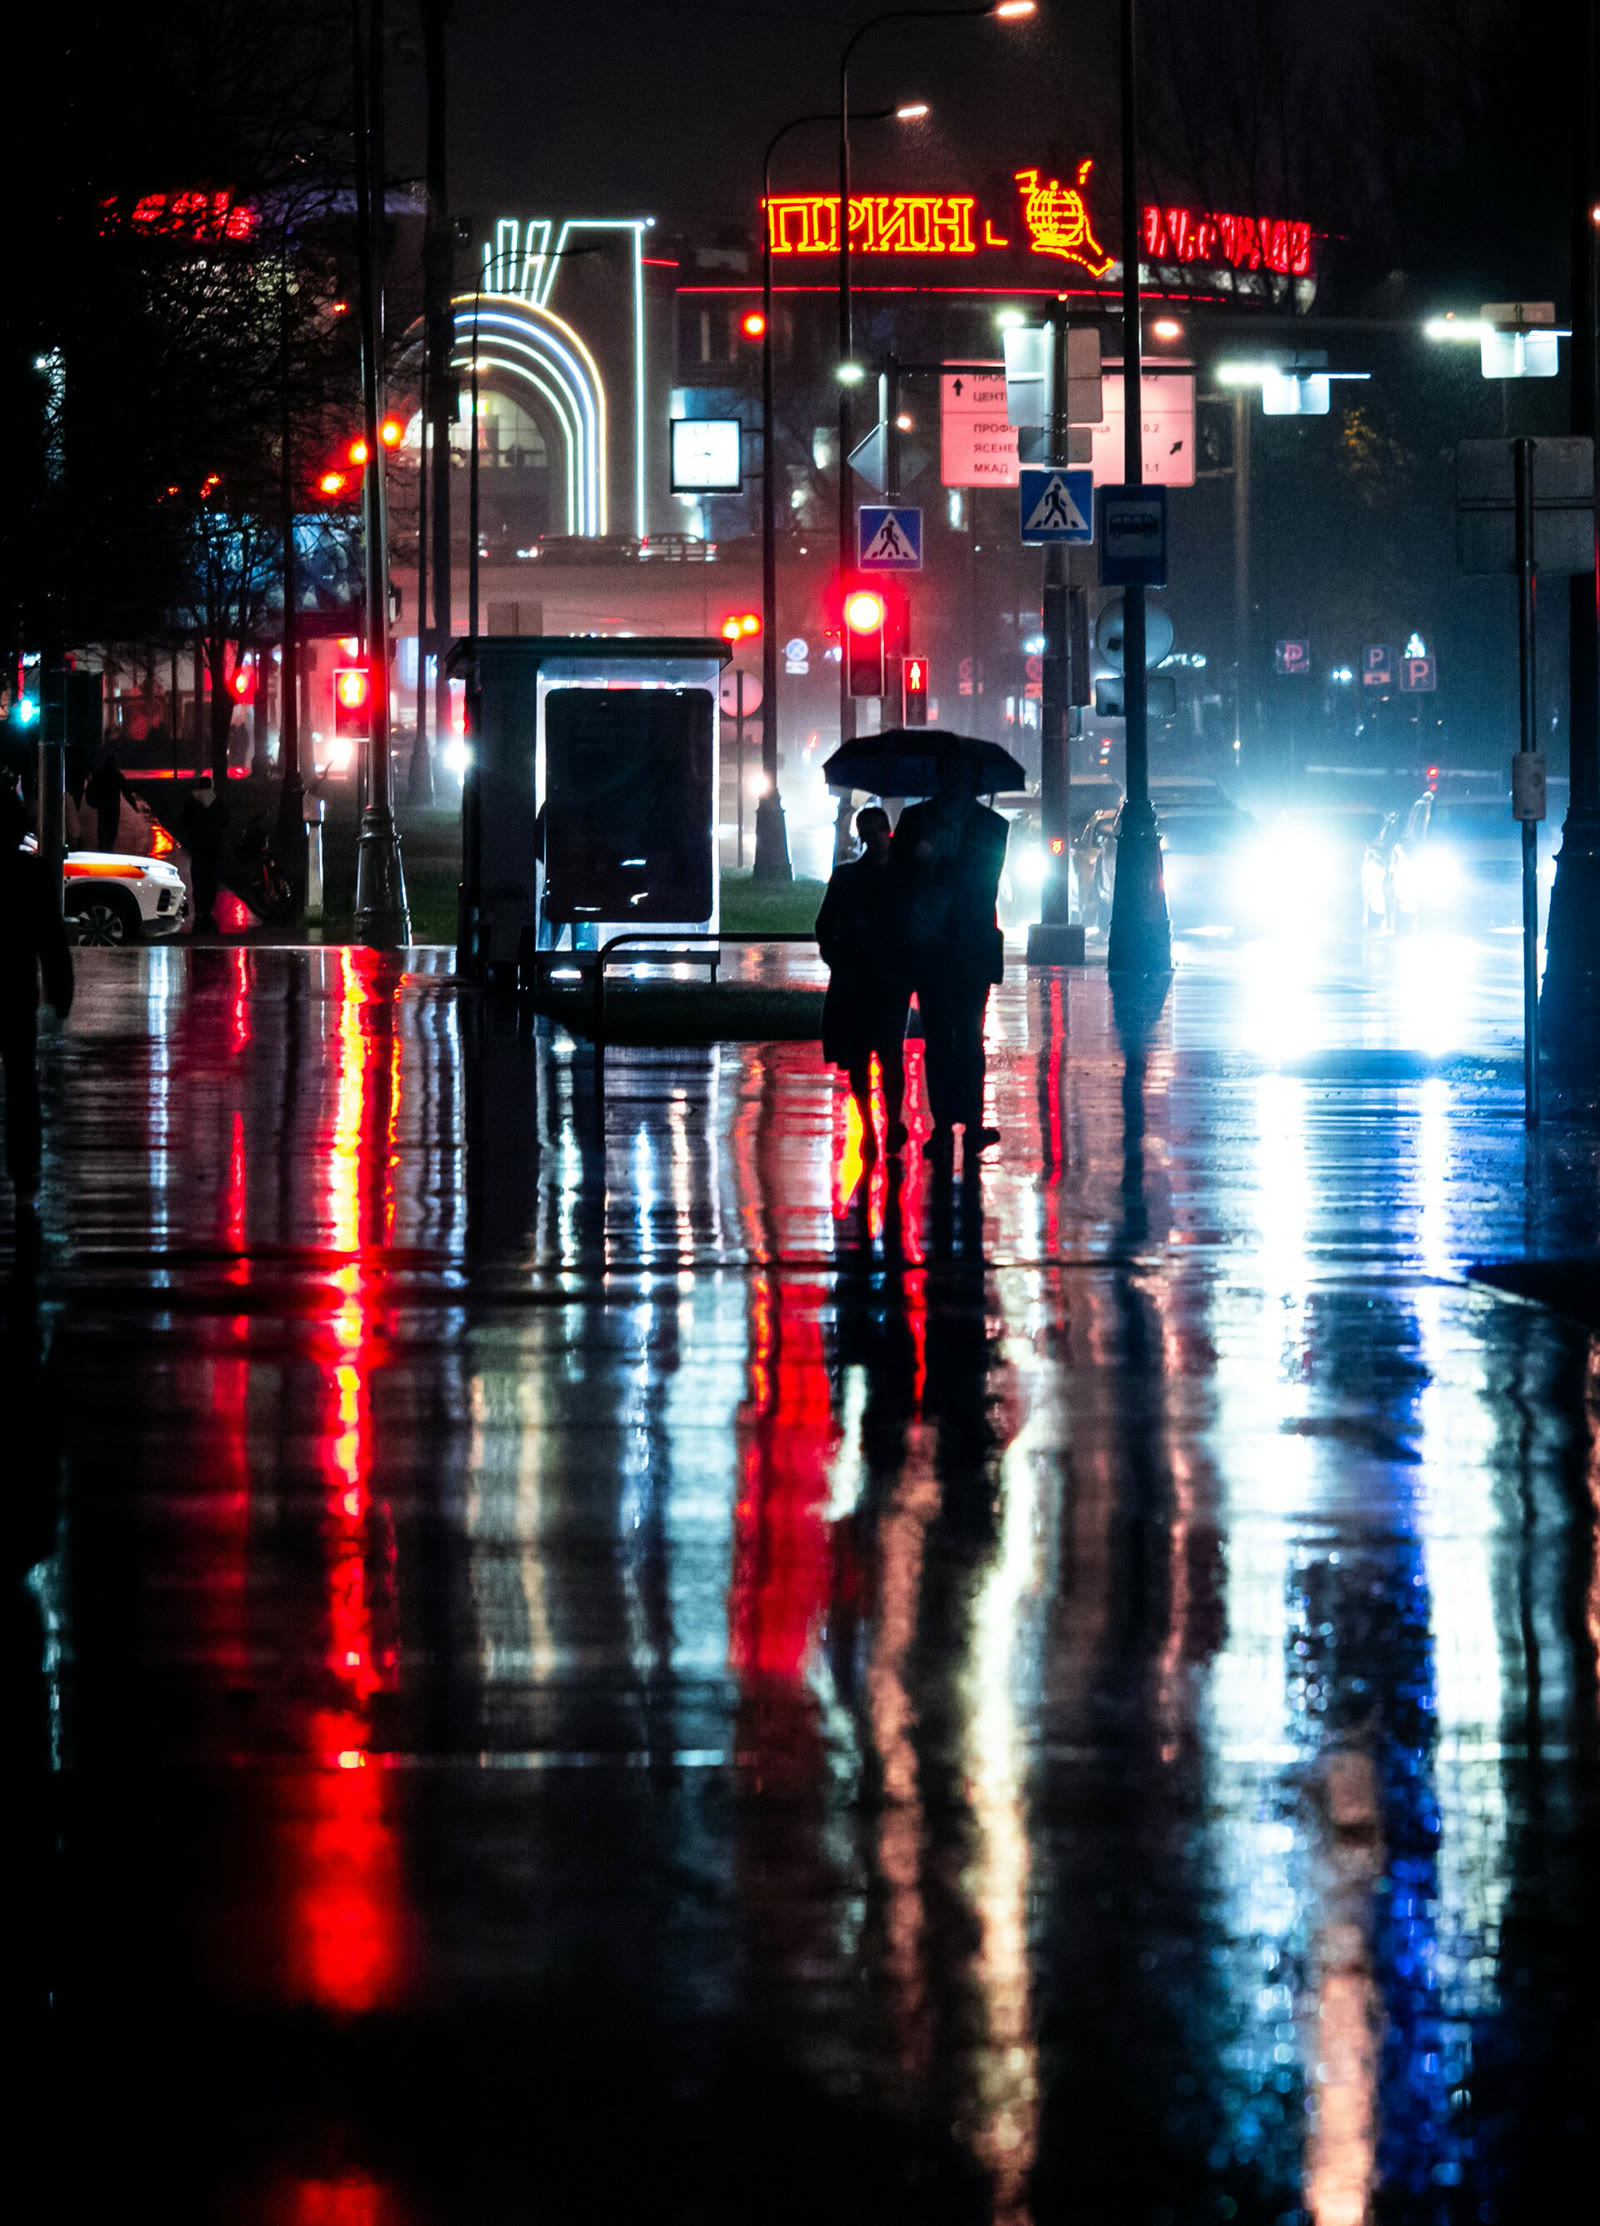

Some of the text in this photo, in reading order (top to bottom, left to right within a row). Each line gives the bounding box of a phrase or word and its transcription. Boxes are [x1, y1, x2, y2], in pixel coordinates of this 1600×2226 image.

[973, 392, 1005, 402] ЦЕНТ
[973, 424, 1018, 433] ПРОФС
[974, 443, 1018, 454] ЯСЕНЕ
[974, 463, 1008, 473] МКАД
[1370, 649, 1384, 668] P
[1410, 660, 1429, 688] P
